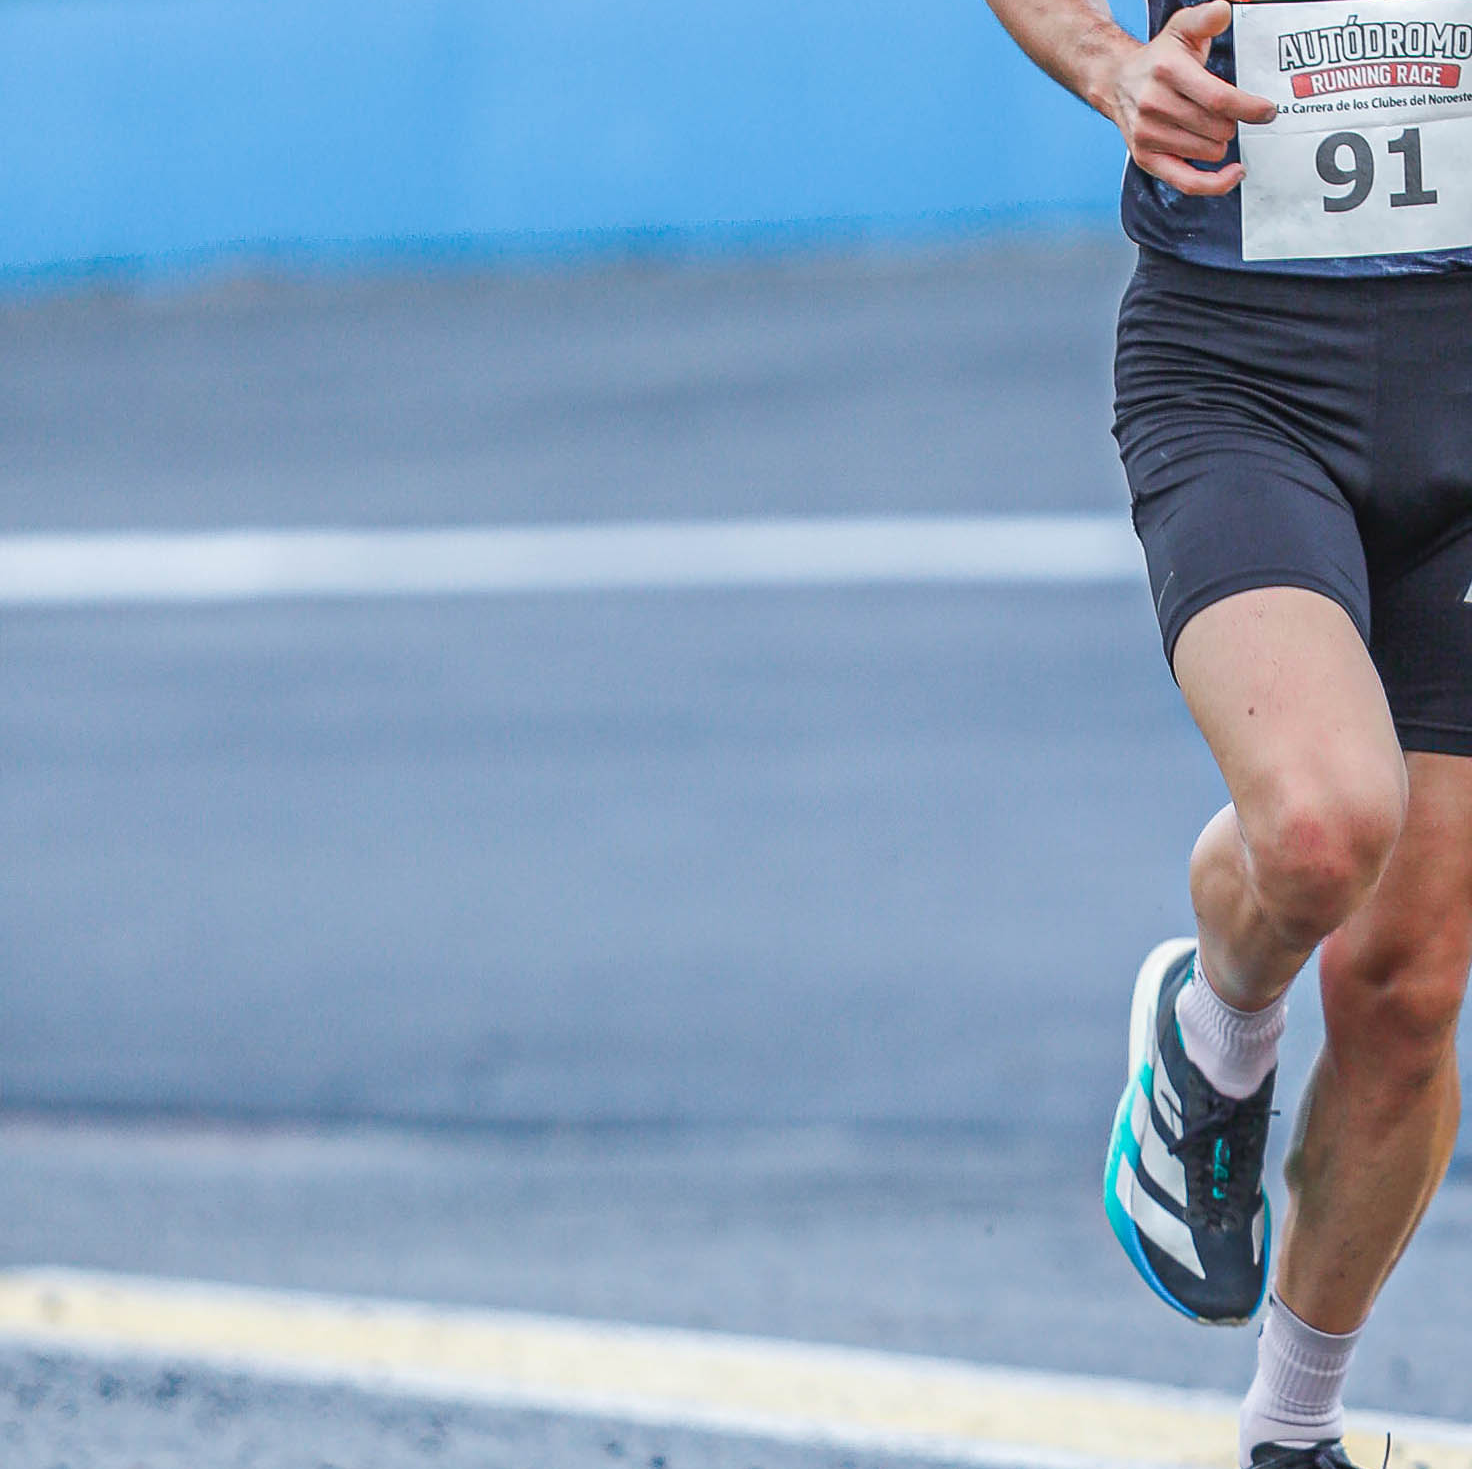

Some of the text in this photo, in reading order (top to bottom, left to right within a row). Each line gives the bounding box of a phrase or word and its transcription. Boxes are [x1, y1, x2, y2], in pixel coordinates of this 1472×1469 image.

[1310, 64, 1443, 94] RUNNING RACE
[1277, 92, 1472, 114] La Carrera de los Clubes del Noroeste
[1316, 127, 1438, 213] 91
